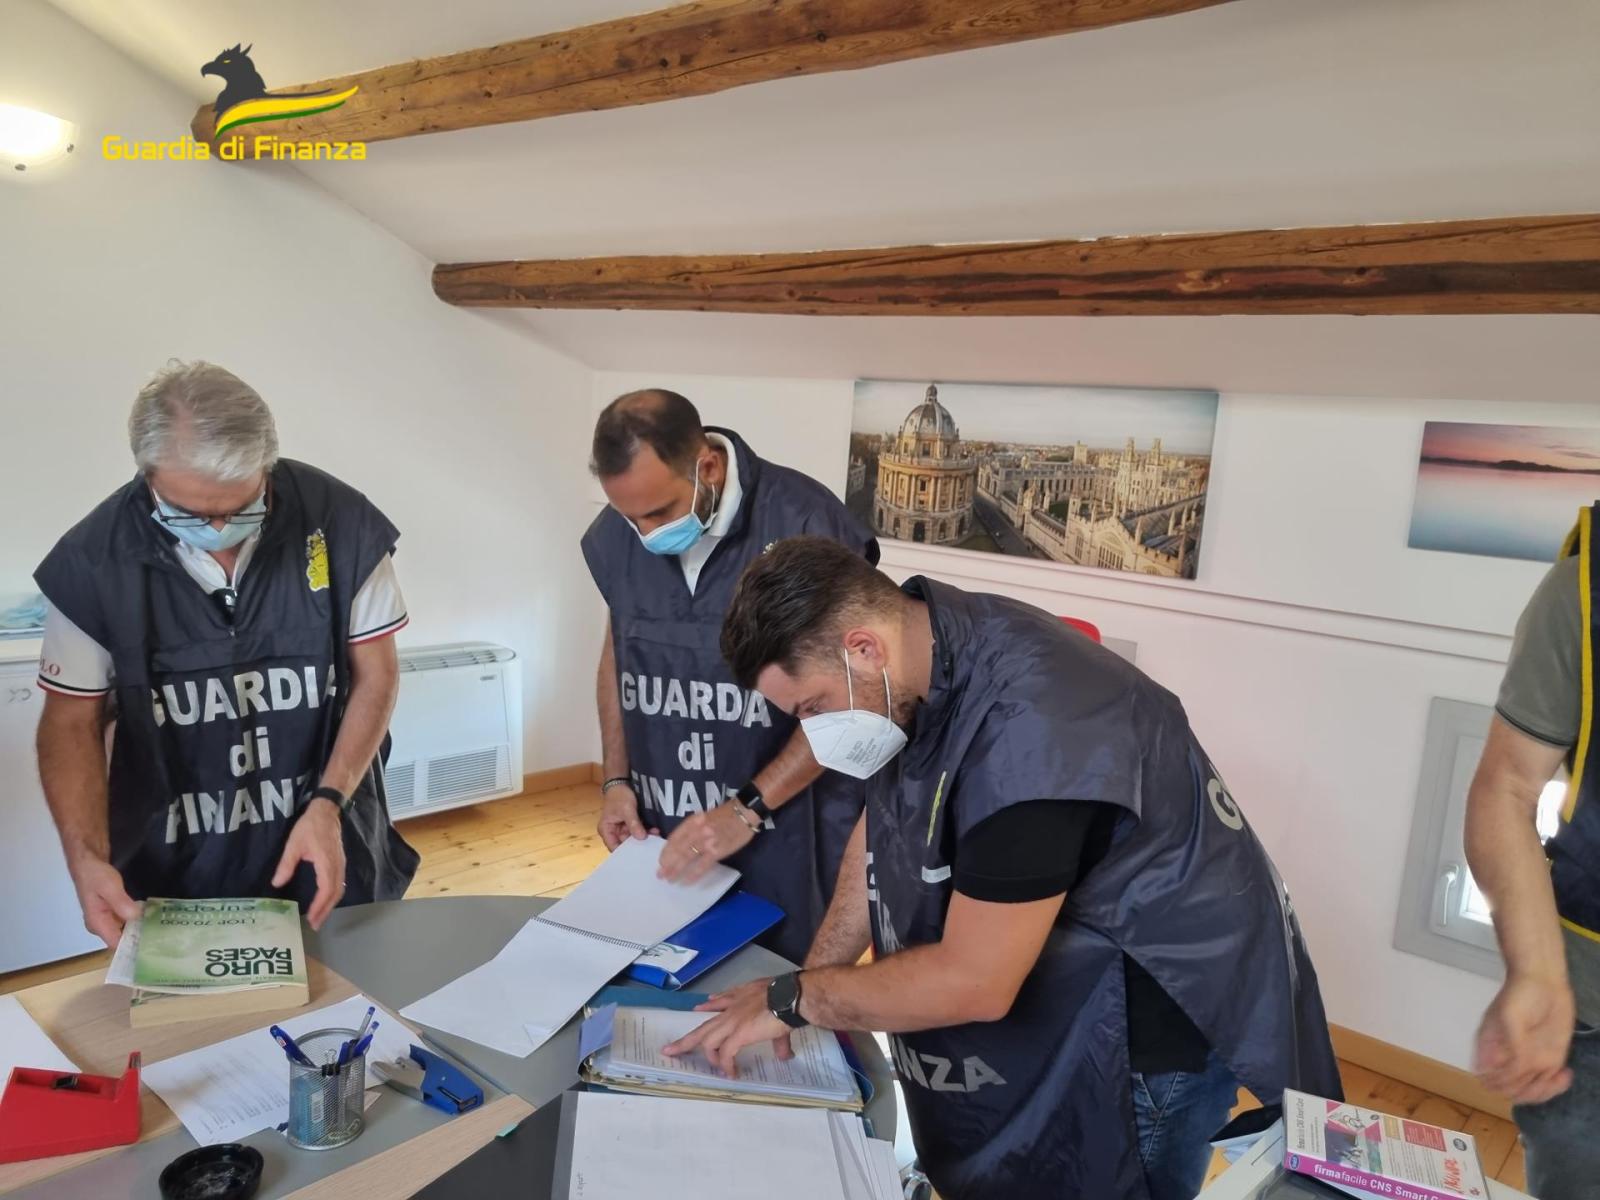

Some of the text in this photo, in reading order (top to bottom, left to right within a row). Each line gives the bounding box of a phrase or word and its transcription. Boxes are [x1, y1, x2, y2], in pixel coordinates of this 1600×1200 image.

[230, 726, 272, 777] di
[678, 732, 716, 770] di
[205, 947, 292, 962] PAGES
[205, 960, 293, 977] EURO
[891, 1034, 1007, 1092] NZA
[1370, 1179, 1392, 1193] CNS
[1395, 1186, 1428, 1200] Smart
